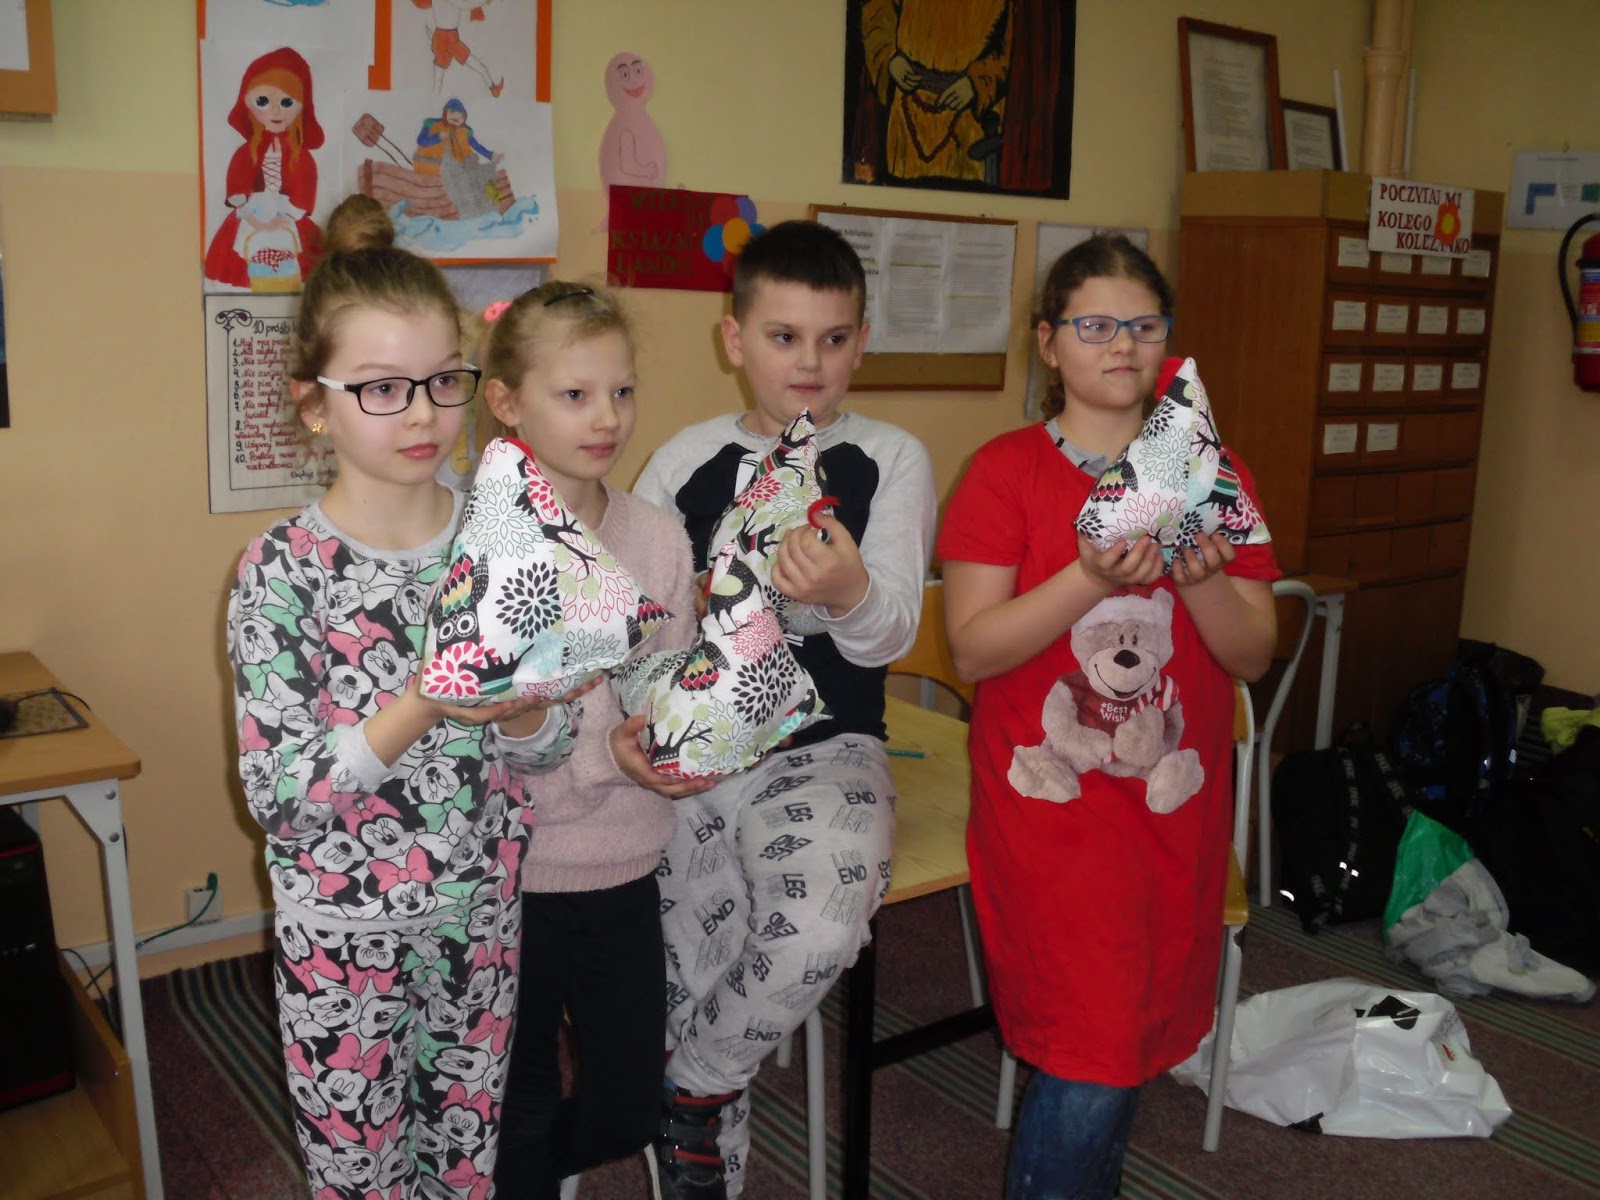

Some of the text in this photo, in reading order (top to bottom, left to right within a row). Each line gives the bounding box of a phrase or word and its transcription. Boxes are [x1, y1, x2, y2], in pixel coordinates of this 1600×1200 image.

[1379, 183, 1441, 206] POCZYTAJ
[1376, 210, 1432, 231] KOLEGO
[253, 320, 265, 334] 10
[1102, 711, 1126, 723] Wish
[1106, 702, 1129, 714] Best
[845, 791, 877, 805] END
[784, 802, 814, 822] LEG
[694, 815, 726, 845] END
[838, 865, 867, 885] END
[782, 873, 807, 900] LEG
[702, 898, 735, 936] END
[802, 964, 838, 985] END
[743, 1028, 782, 1042] END
